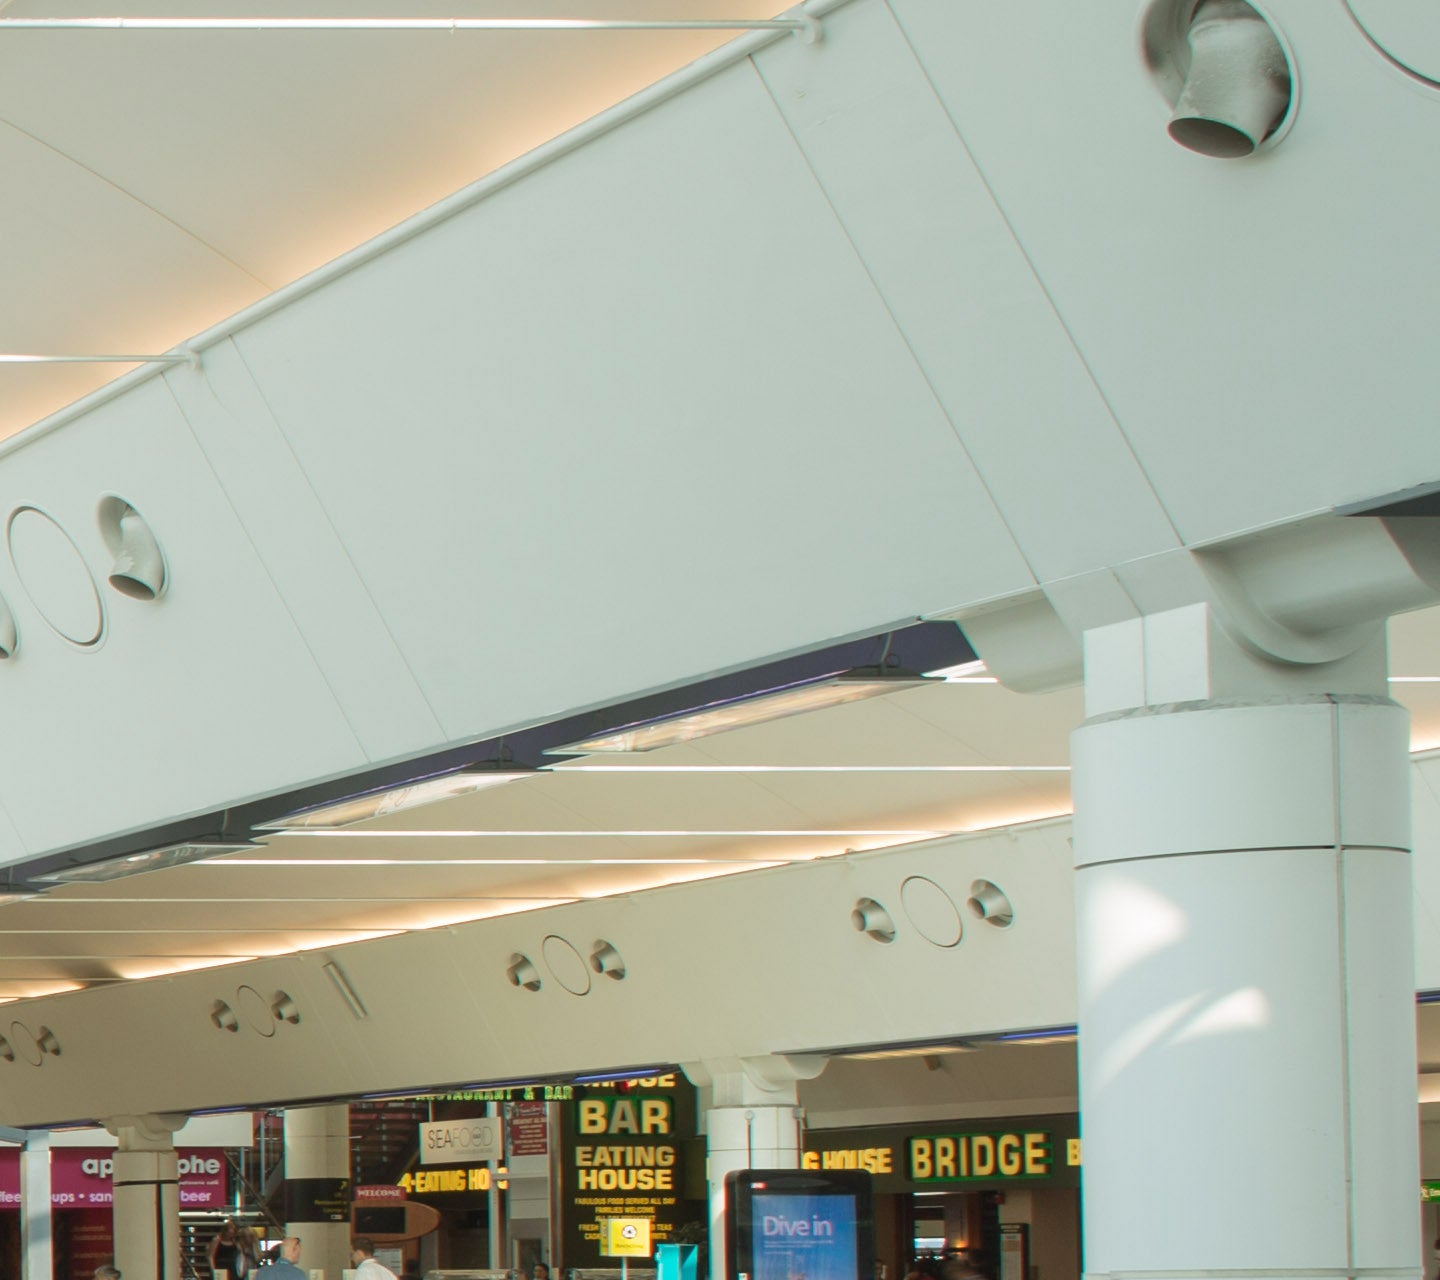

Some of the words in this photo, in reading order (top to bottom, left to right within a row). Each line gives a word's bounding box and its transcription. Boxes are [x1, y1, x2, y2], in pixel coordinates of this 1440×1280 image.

[545, 1086, 574, 1100] BAR
[580, 1099, 670, 1134] BAR
[576, 1146, 676, 1167] EATING
[821, 1147, 892, 1174] HOUSE
[911, 1133, 1049, 1178] BRIDGE
[579, 1169, 673, 1190] HOUSE
[50, 1193, 75, 1204] ups
[180, 1190, 212, 1202] beer
[357, 1188, 401, 1198] WELCOME
[762, 1215, 811, 1237] Dive
[813, 1215, 832, 1236] in
